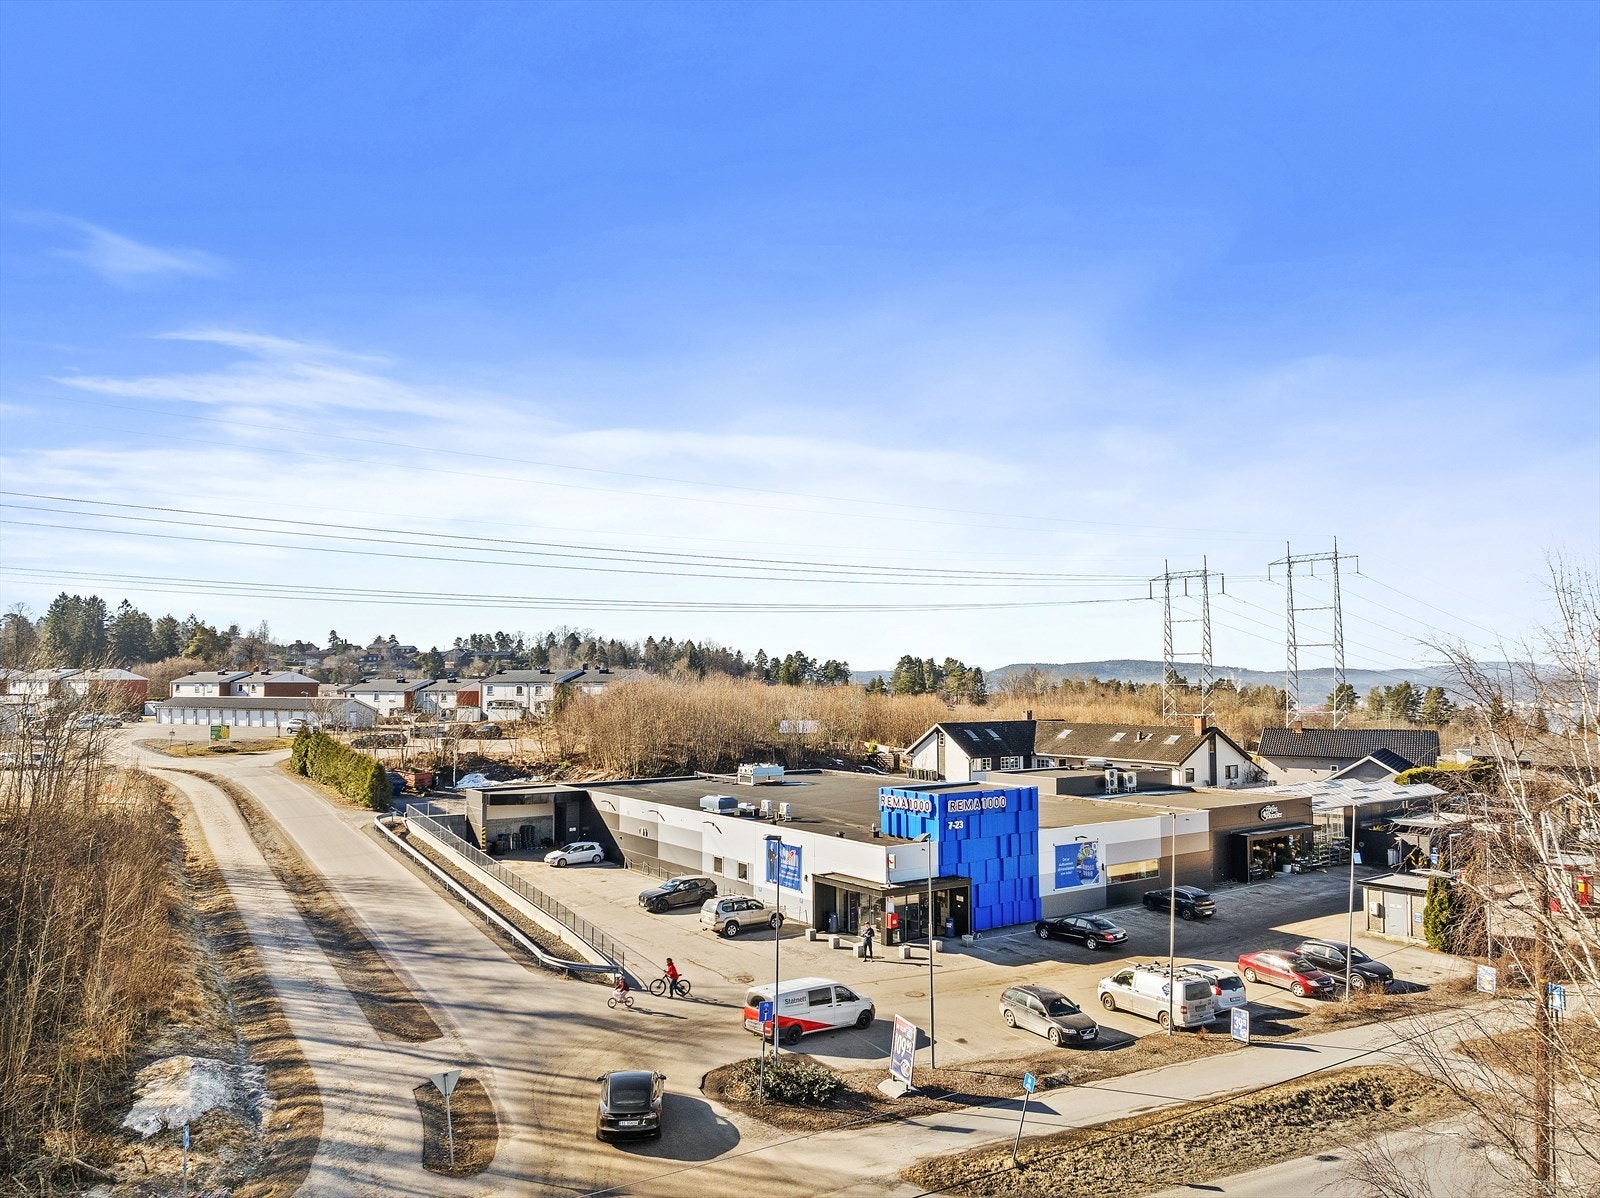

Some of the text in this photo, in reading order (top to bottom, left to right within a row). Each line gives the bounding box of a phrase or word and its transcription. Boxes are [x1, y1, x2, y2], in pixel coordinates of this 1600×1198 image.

[880, 794, 932, 812] REMA 1000
[948, 796, 1007, 812] REMA 1000
[948, 821, 964, 830] 7-23
